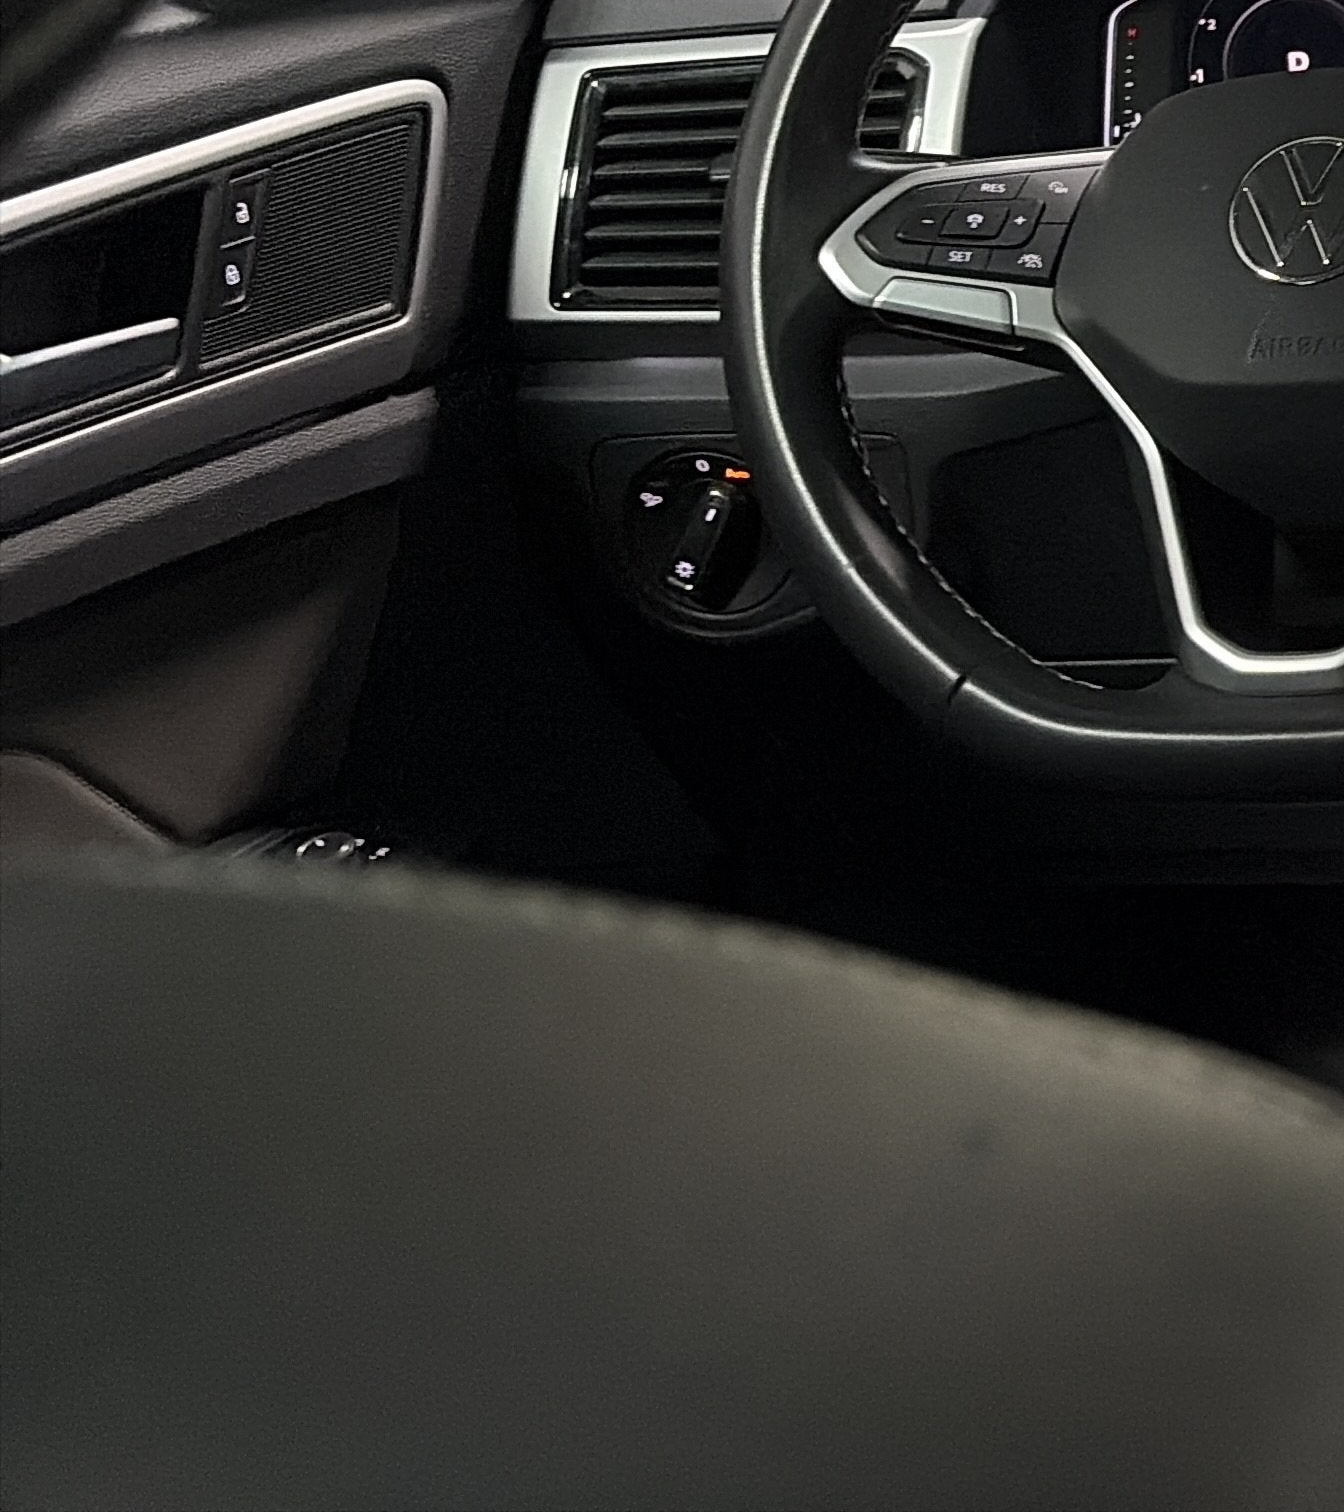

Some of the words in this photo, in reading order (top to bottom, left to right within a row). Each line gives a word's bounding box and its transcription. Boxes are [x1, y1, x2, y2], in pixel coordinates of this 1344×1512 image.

[1206, 18, 1217, 31] 2
[1286, 50, 1310, 73] D
[1196, 68, 1204, 84] 1
[980, 182, 1006, 194] RES
[947, 250, 973, 263] SET
